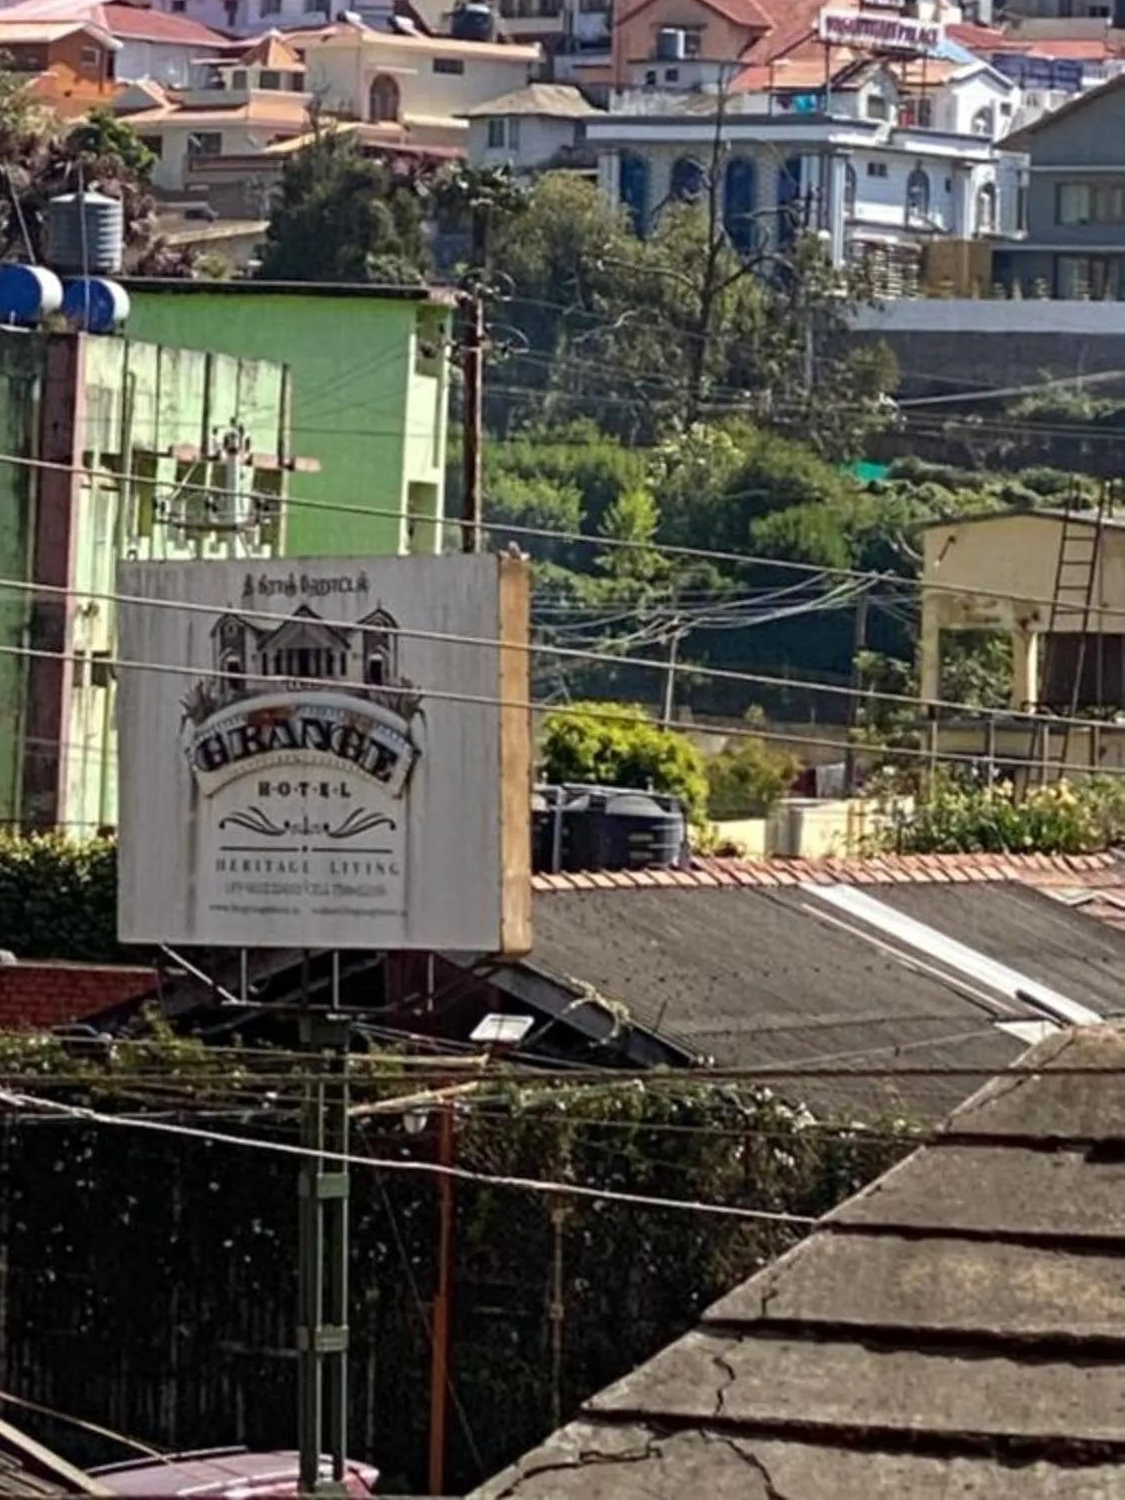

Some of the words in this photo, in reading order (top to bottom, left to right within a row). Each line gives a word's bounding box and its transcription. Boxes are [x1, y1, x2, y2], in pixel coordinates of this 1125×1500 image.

[193, 716, 399, 783] GRANGE
[215, 858, 311, 874] HERITAGE
[329, 861, 400, 876] LIVING
